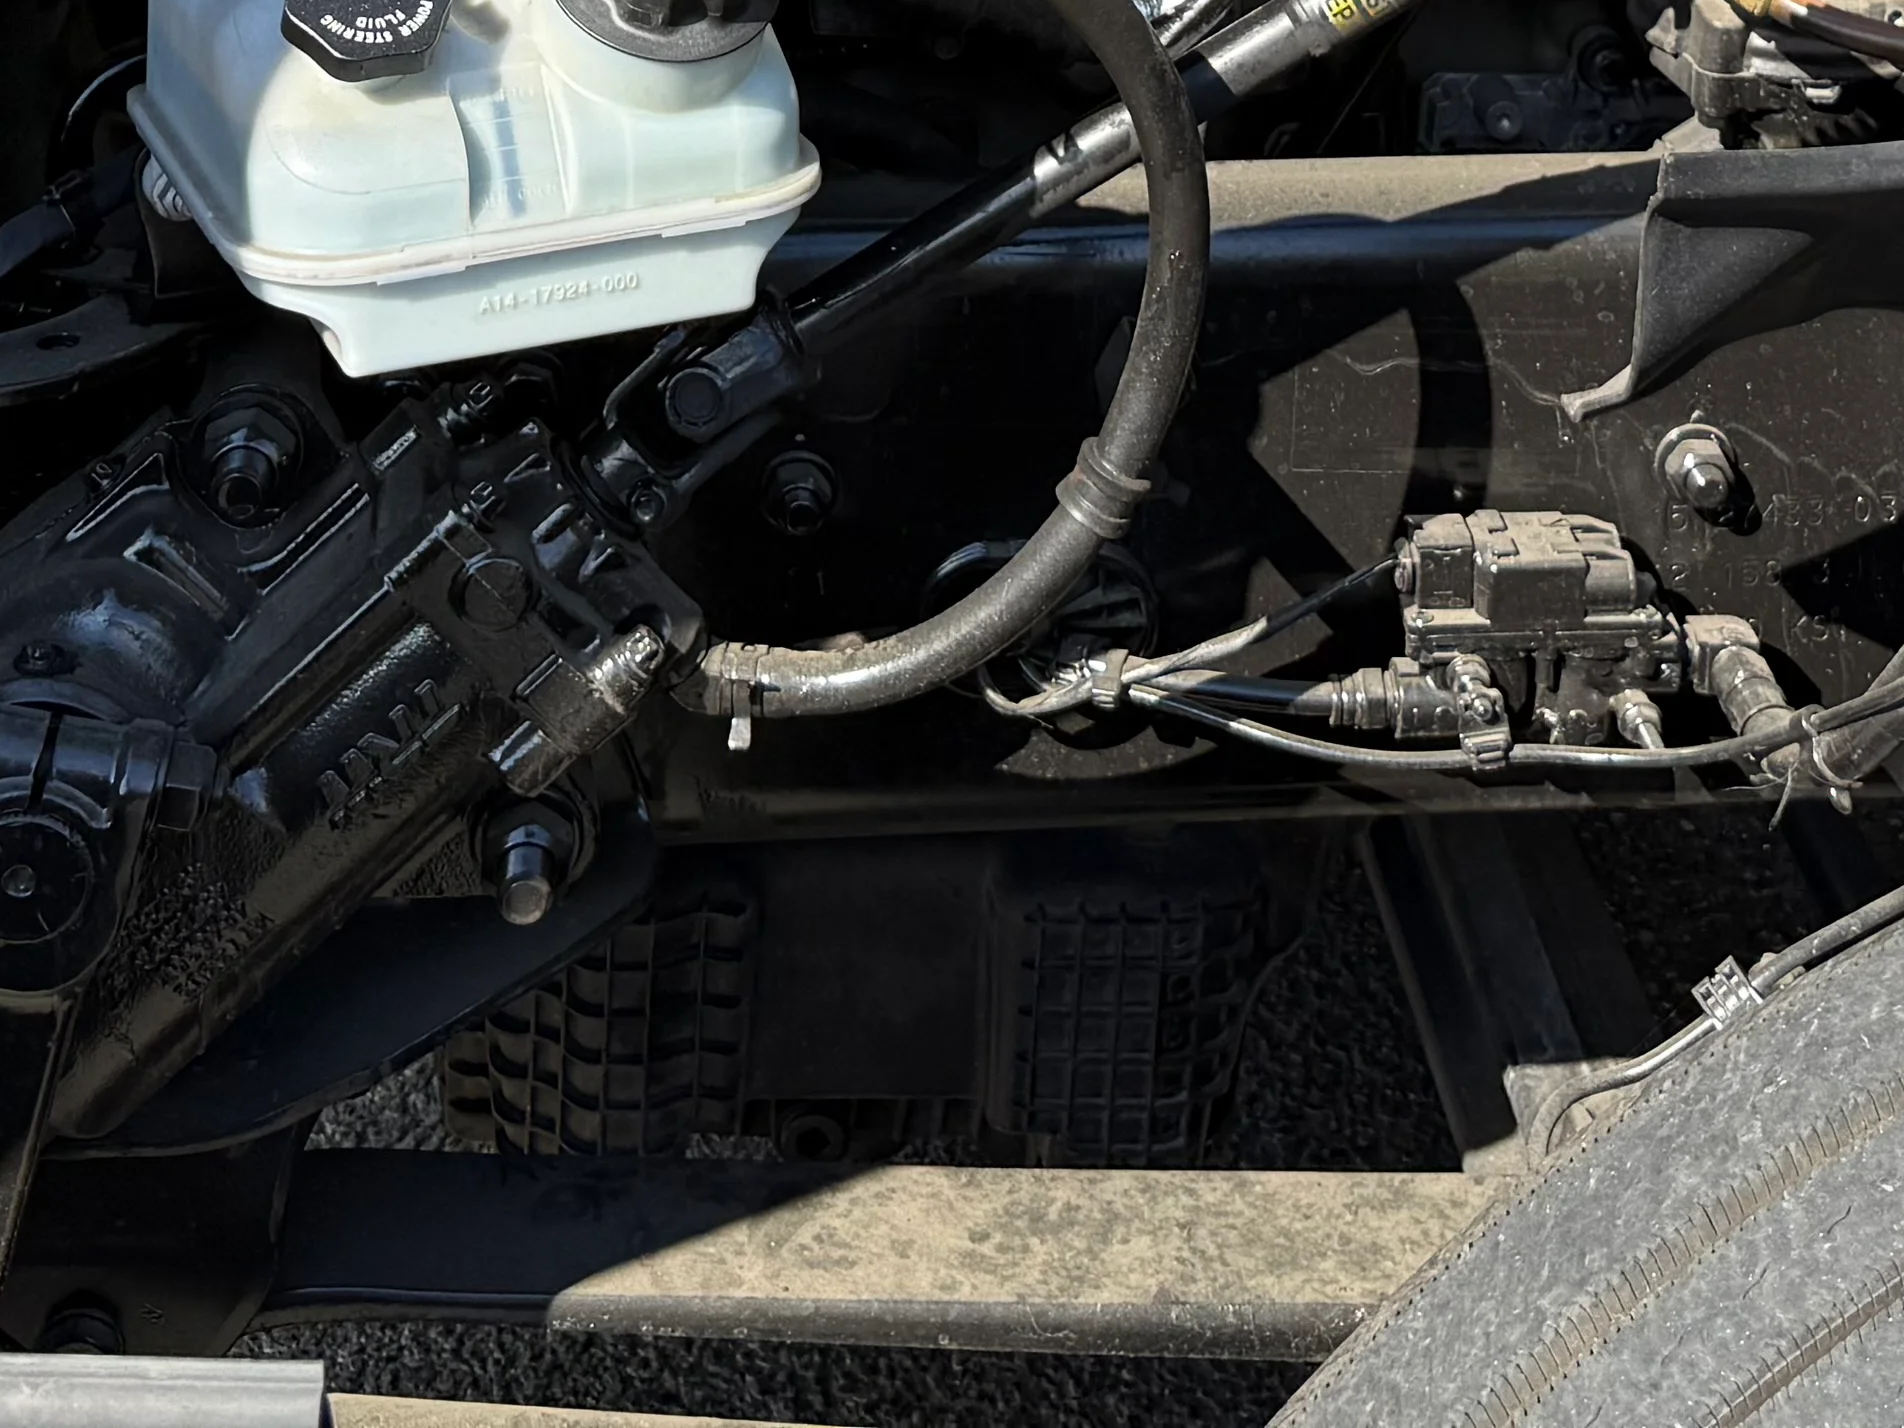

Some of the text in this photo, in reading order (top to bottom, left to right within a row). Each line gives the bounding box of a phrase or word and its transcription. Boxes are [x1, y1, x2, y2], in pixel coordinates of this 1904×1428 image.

[320, 0, 434, 44] POWER STEERING
[356, 8, 406, 29] FLUID
[479, 272, 639, 315] A14-17924-000
